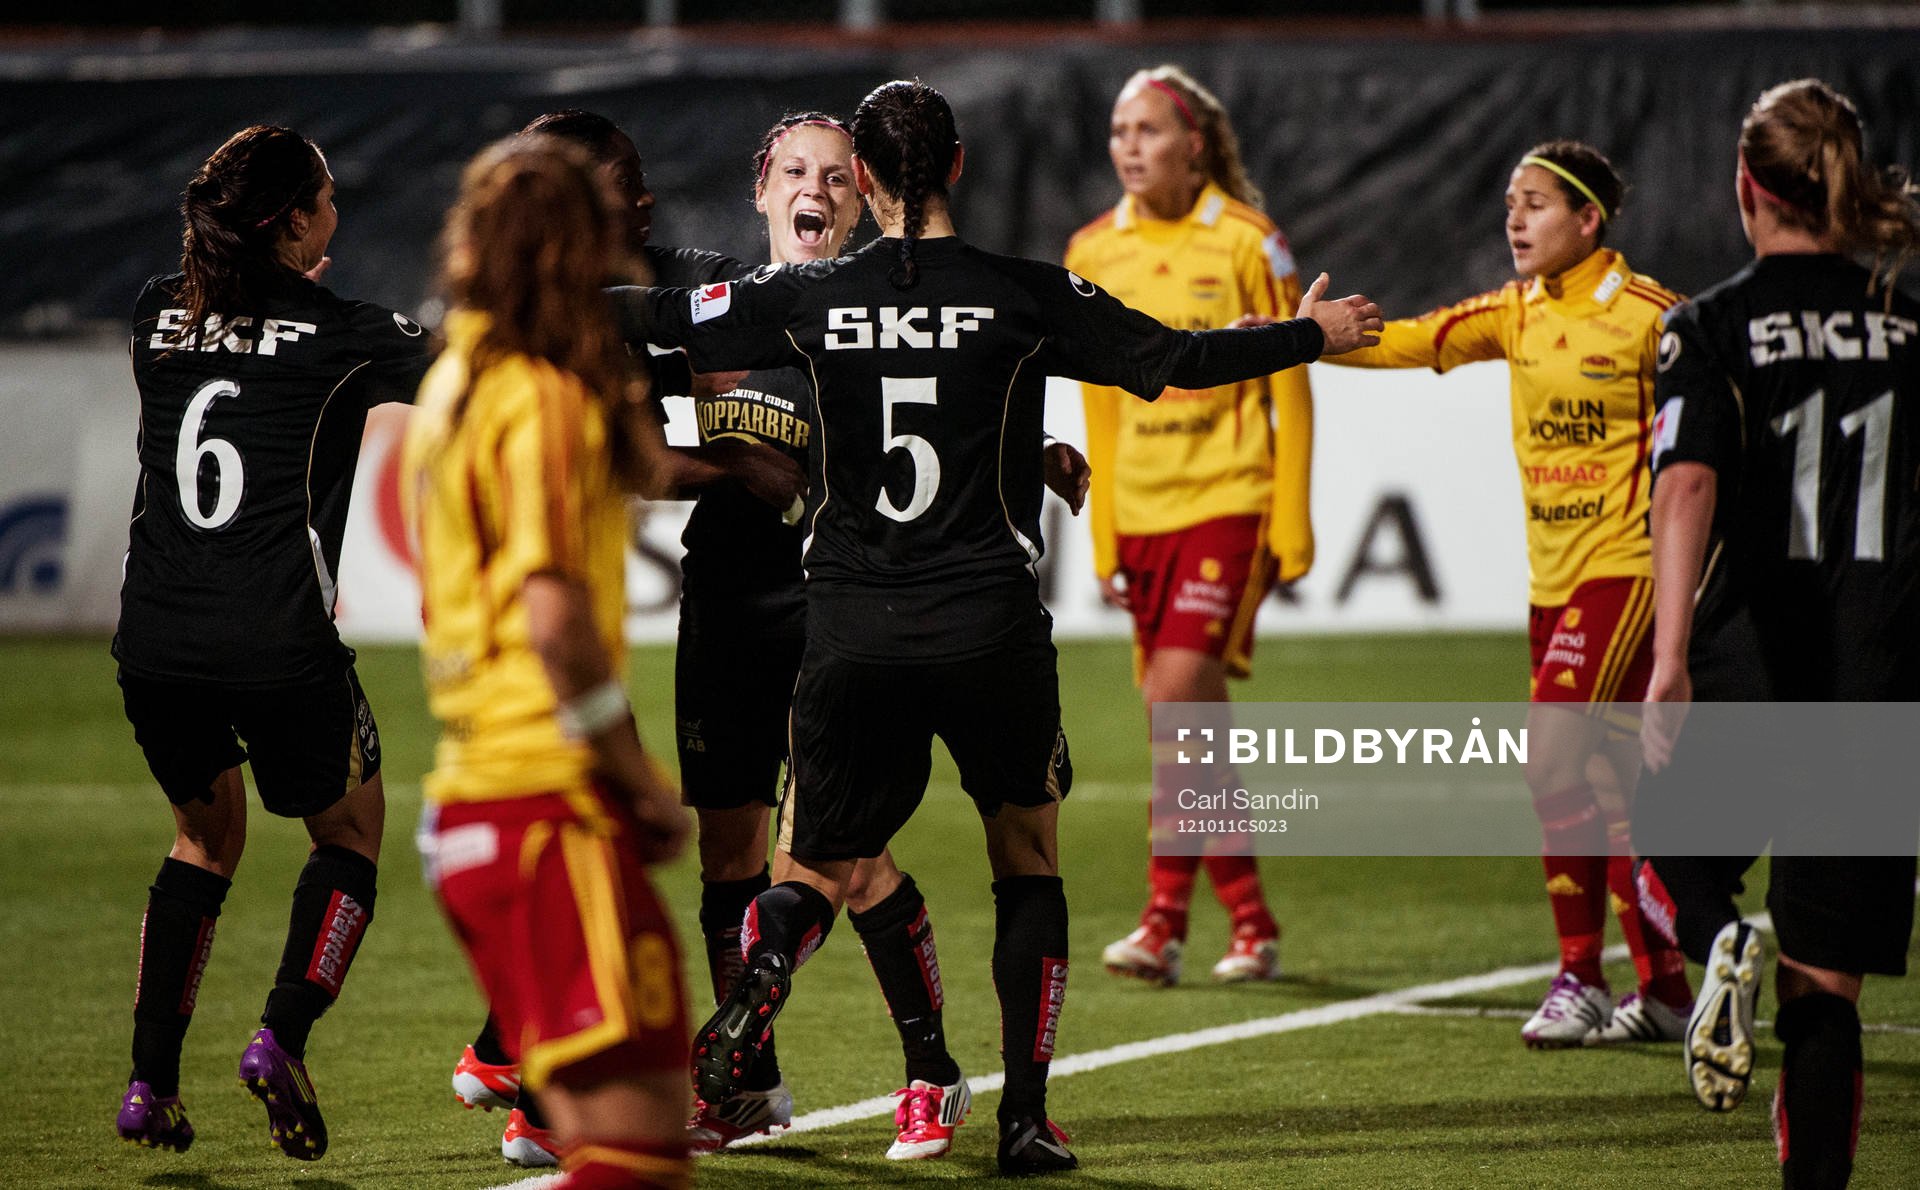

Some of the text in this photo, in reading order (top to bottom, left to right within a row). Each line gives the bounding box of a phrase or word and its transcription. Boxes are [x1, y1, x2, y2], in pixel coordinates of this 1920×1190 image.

[150, 308, 317, 356] SKF
[824, 306, 994, 350] SKF
[1748, 309, 1918, 368] SKF
[716, 388, 796, 413] EMIUM CIDER
[1567, 399, 1604, 419] UN
[175, 379, 245, 530] 6
[875, 376, 941, 522] 5
[1769, 388, 1894, 564] 11
